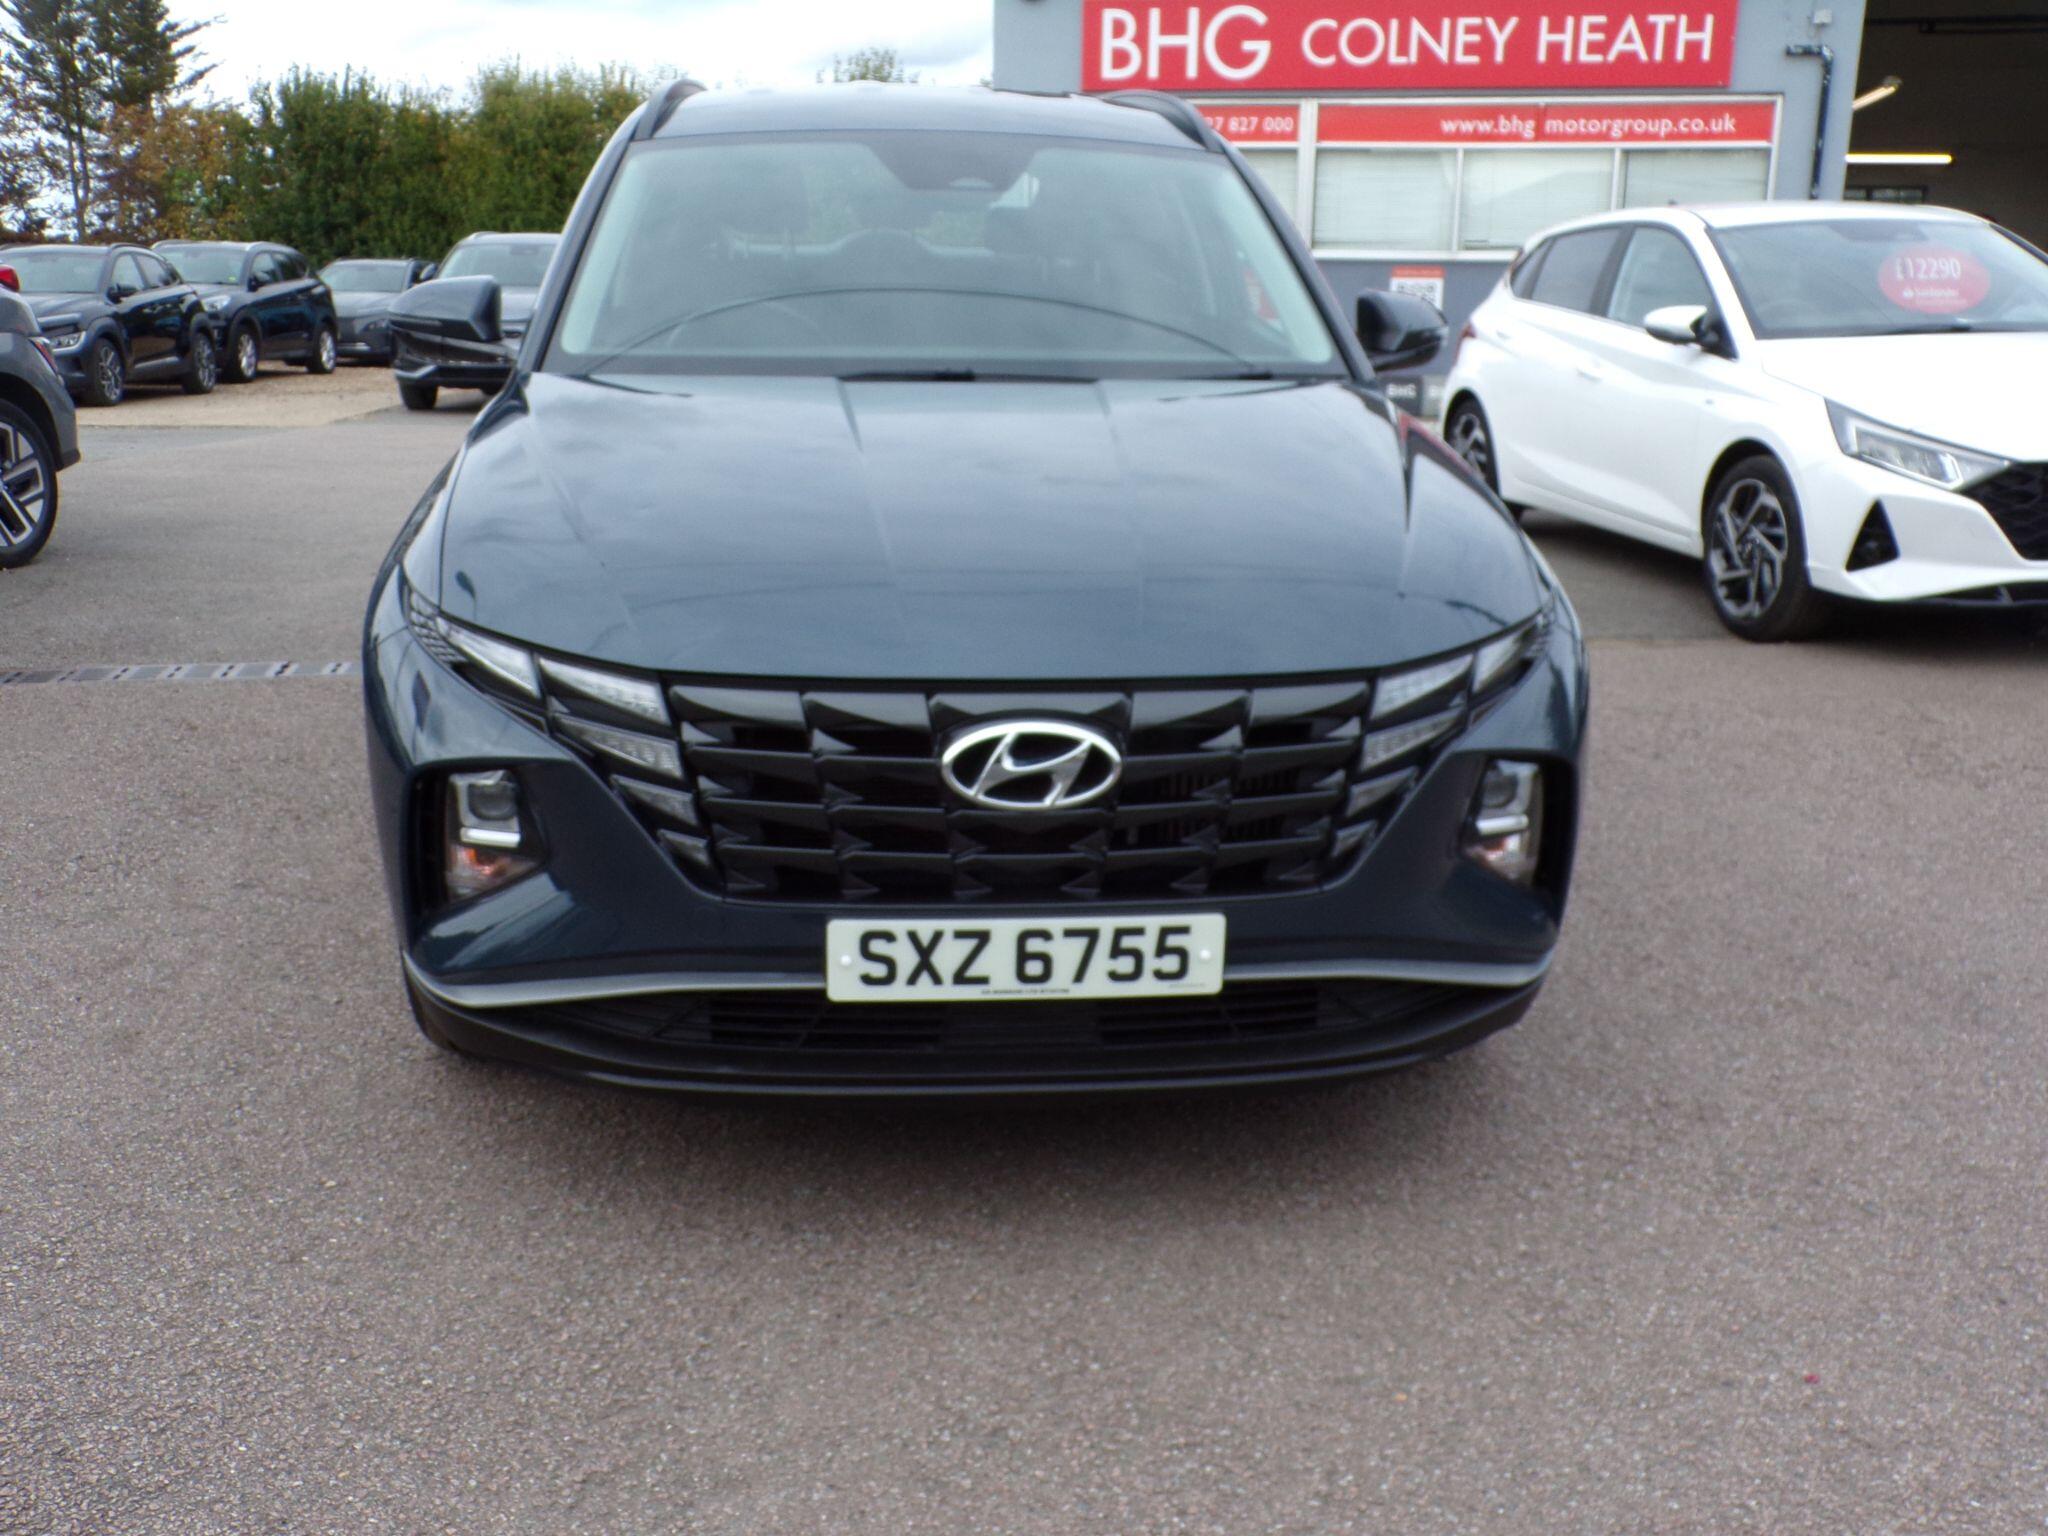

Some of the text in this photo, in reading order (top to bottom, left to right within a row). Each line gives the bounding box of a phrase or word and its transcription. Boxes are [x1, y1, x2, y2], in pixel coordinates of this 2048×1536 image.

[1100, 5, 1715, 80] BHG COLNEY HEATH
[1228, 116, 1259, 131] 827
[1262, 116, 1294, 131] 000
[858, 926, 1192, 986] SXZ 6755
